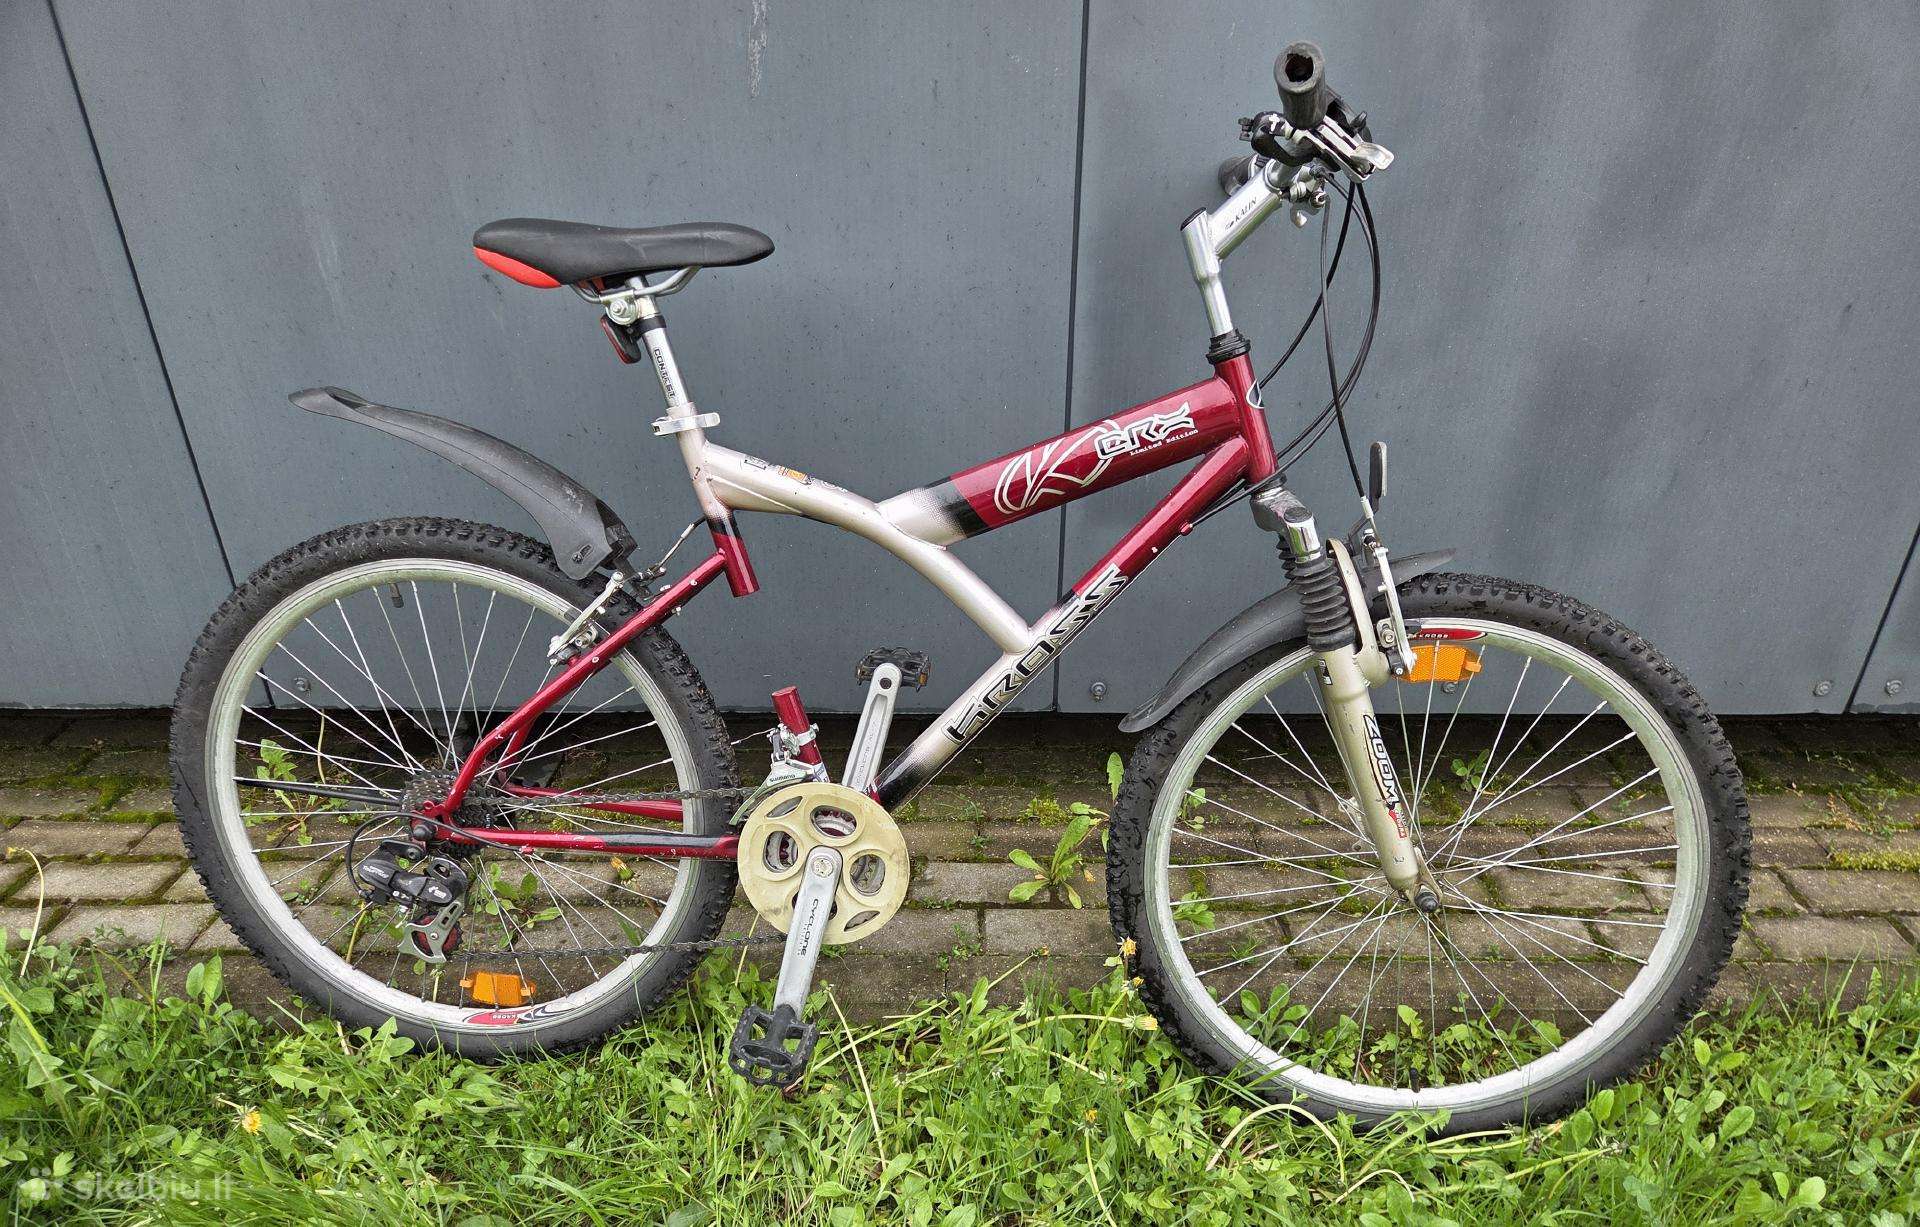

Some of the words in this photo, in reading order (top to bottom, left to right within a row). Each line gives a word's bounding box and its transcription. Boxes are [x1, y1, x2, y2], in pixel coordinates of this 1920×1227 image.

[654, 348, 676, 399] CONTEST
[1094, 401, 1195, 460] CRX
[1129, 441, 1162, 456] Limited
[1166, 429, 1199, 444] Edition
[943, 563, 1128, 743] KROSS
[1363, 714, 1400, 804] ZOOM
